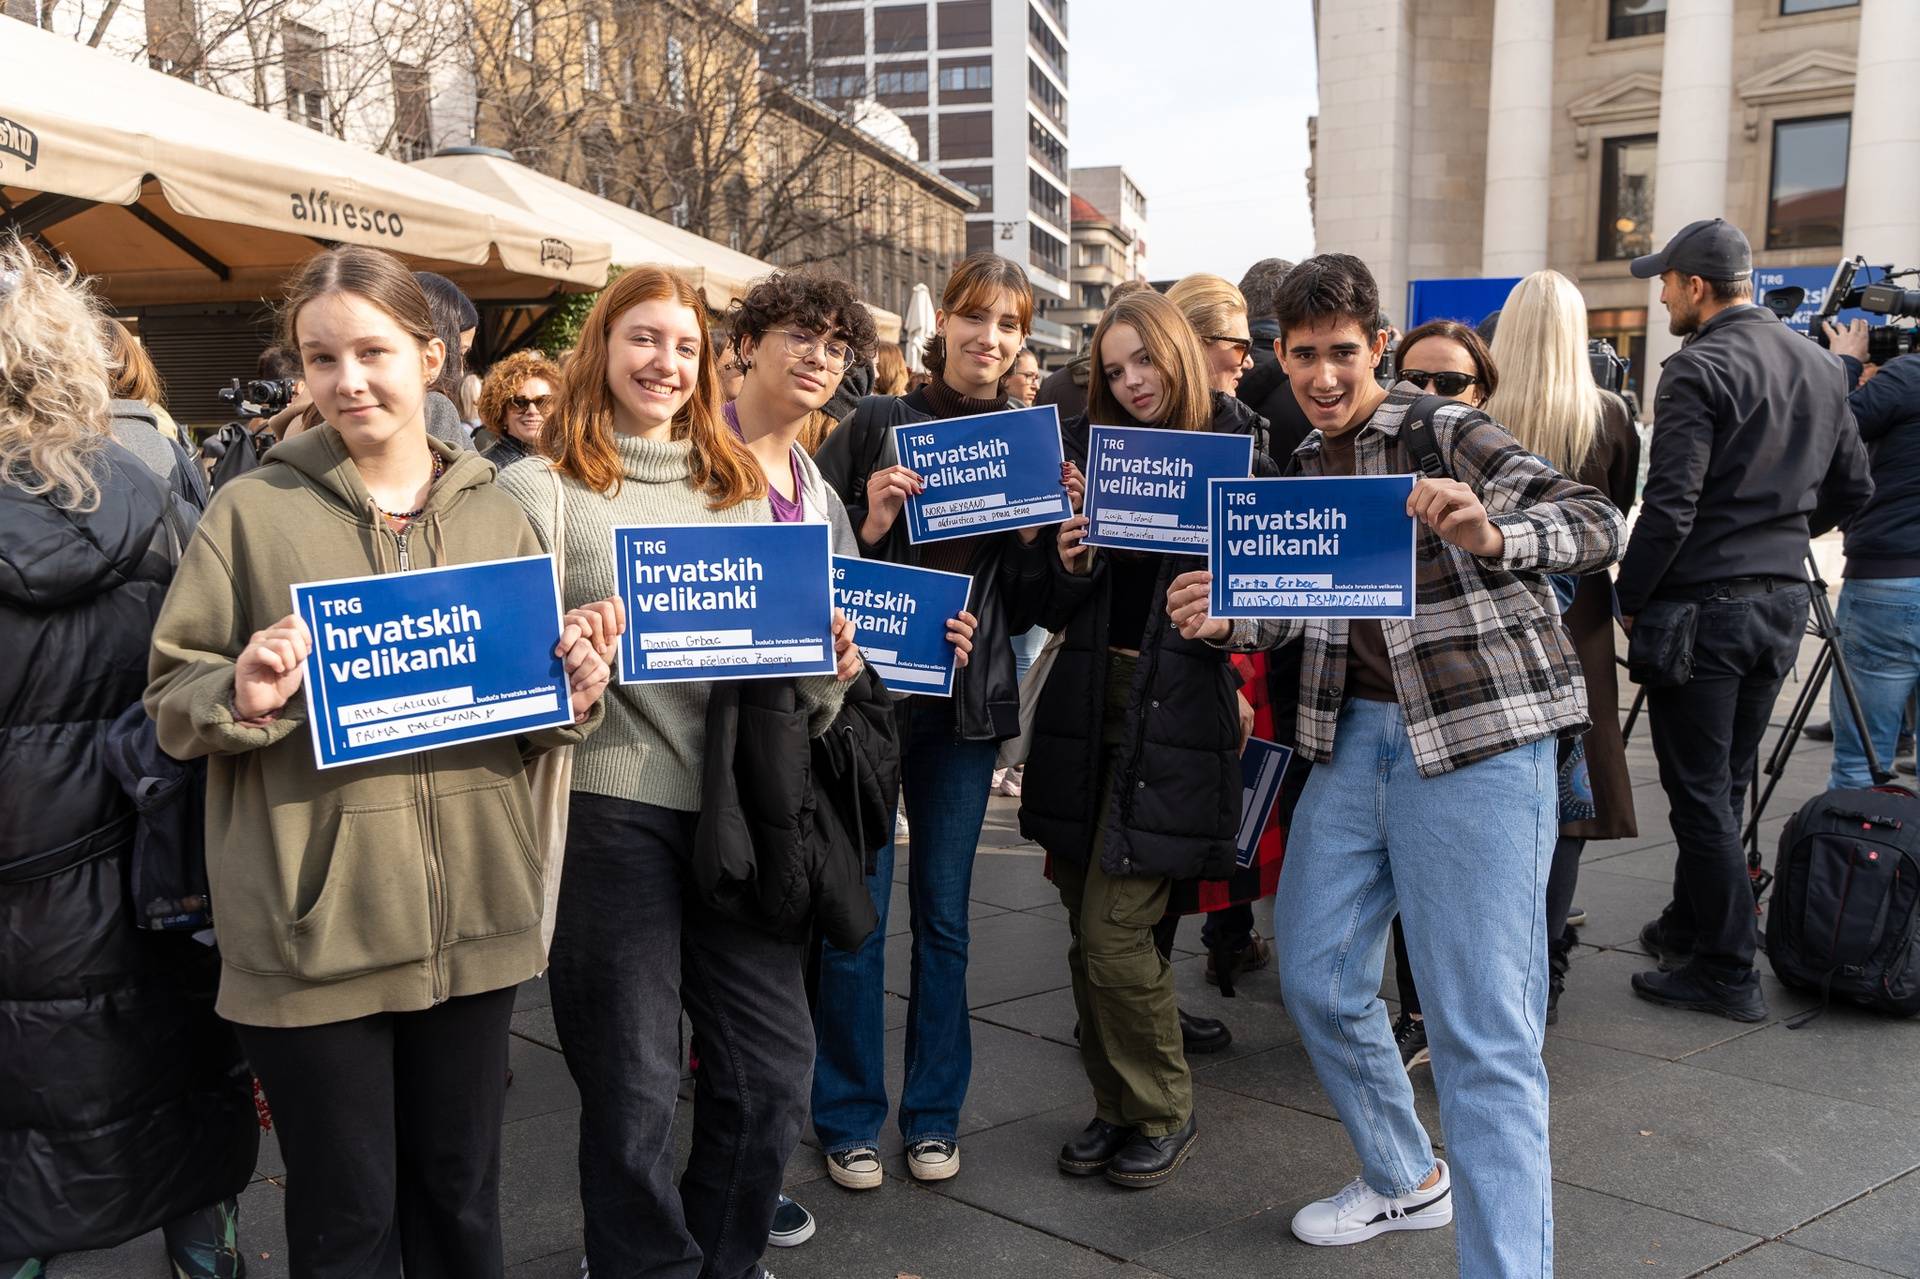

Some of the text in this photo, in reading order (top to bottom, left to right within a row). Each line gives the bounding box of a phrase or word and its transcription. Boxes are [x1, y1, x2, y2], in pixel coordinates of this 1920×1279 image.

[290, 188, 404, 237] alfresco
[1761, 275, 1784, 285] TRG
[910, 434, 935, 447] TRG
[1103, 438, 1125, 450] TRG
[913, 438, 1010, 468] hrvatskih
[1100, 453, 1194, 478] hrvatskih
[1099, 476, 1187, 499] velikanki
[1227, 493, 1256, 505] TRG
[1227, 508, 1347, 531] hrvatskih
[633, 540, 667, 555] TRG
[1227, 533, 1339, 556] velikanki
[635, 557, 763, 584] hrvatskih
[320, 597, 363, 617] TRG
[636, 585, 757, 613] velikanki
[832, 587, 917, 614] rvatskih
[324, 604, 482, 651] hrvatskih
[329, 635, 477, 683] velikanki
